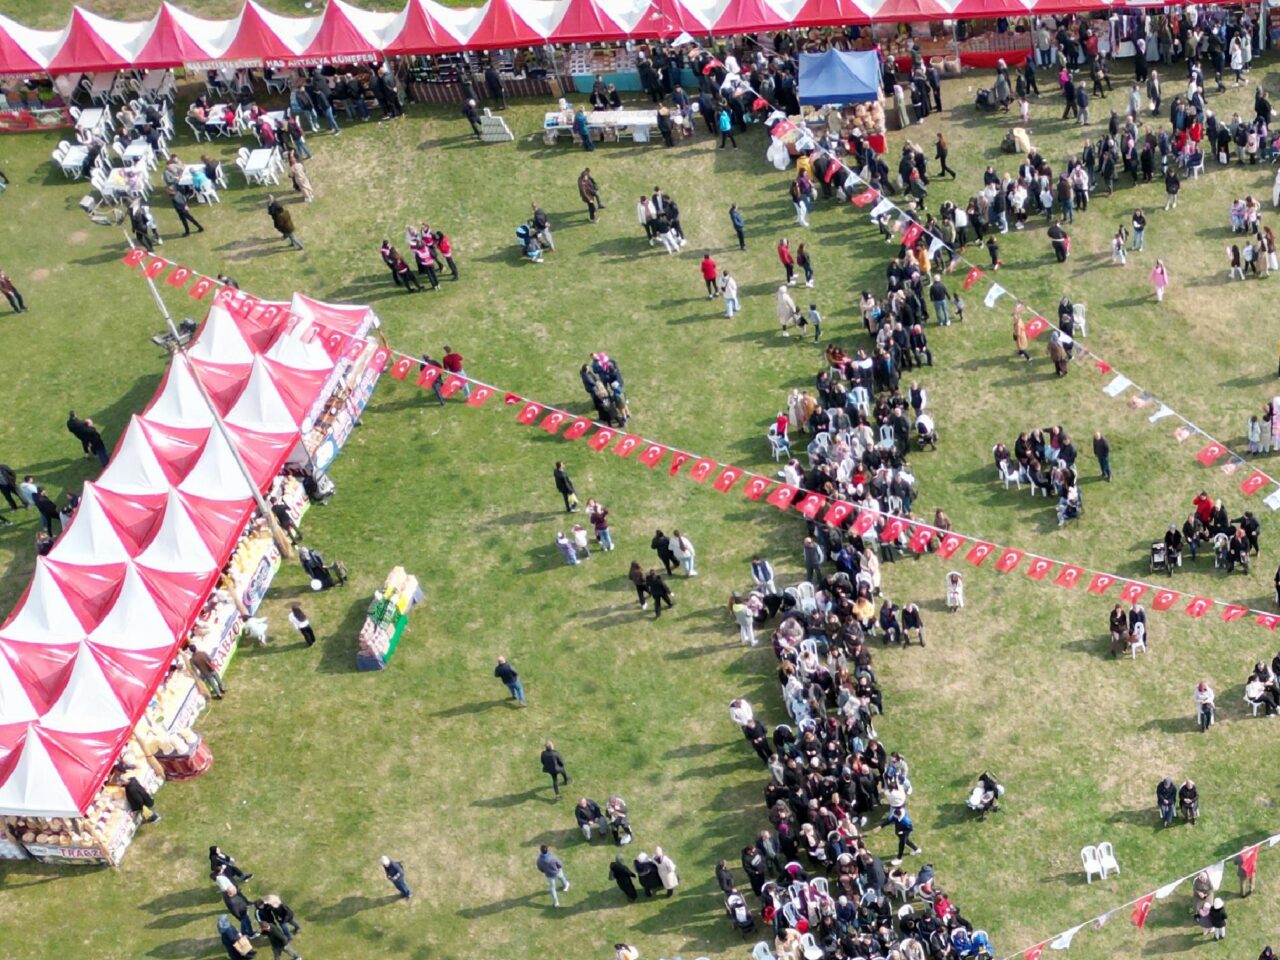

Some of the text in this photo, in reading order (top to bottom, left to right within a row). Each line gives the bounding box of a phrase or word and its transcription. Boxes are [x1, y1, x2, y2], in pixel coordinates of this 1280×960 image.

[266, 59, 286, 68] HAS
[287, 56, 331, 67] ANTAKYA
[331, 51, 377, 65] KÜNEFESİ
[60, 847, 103, 857] TRABZ
